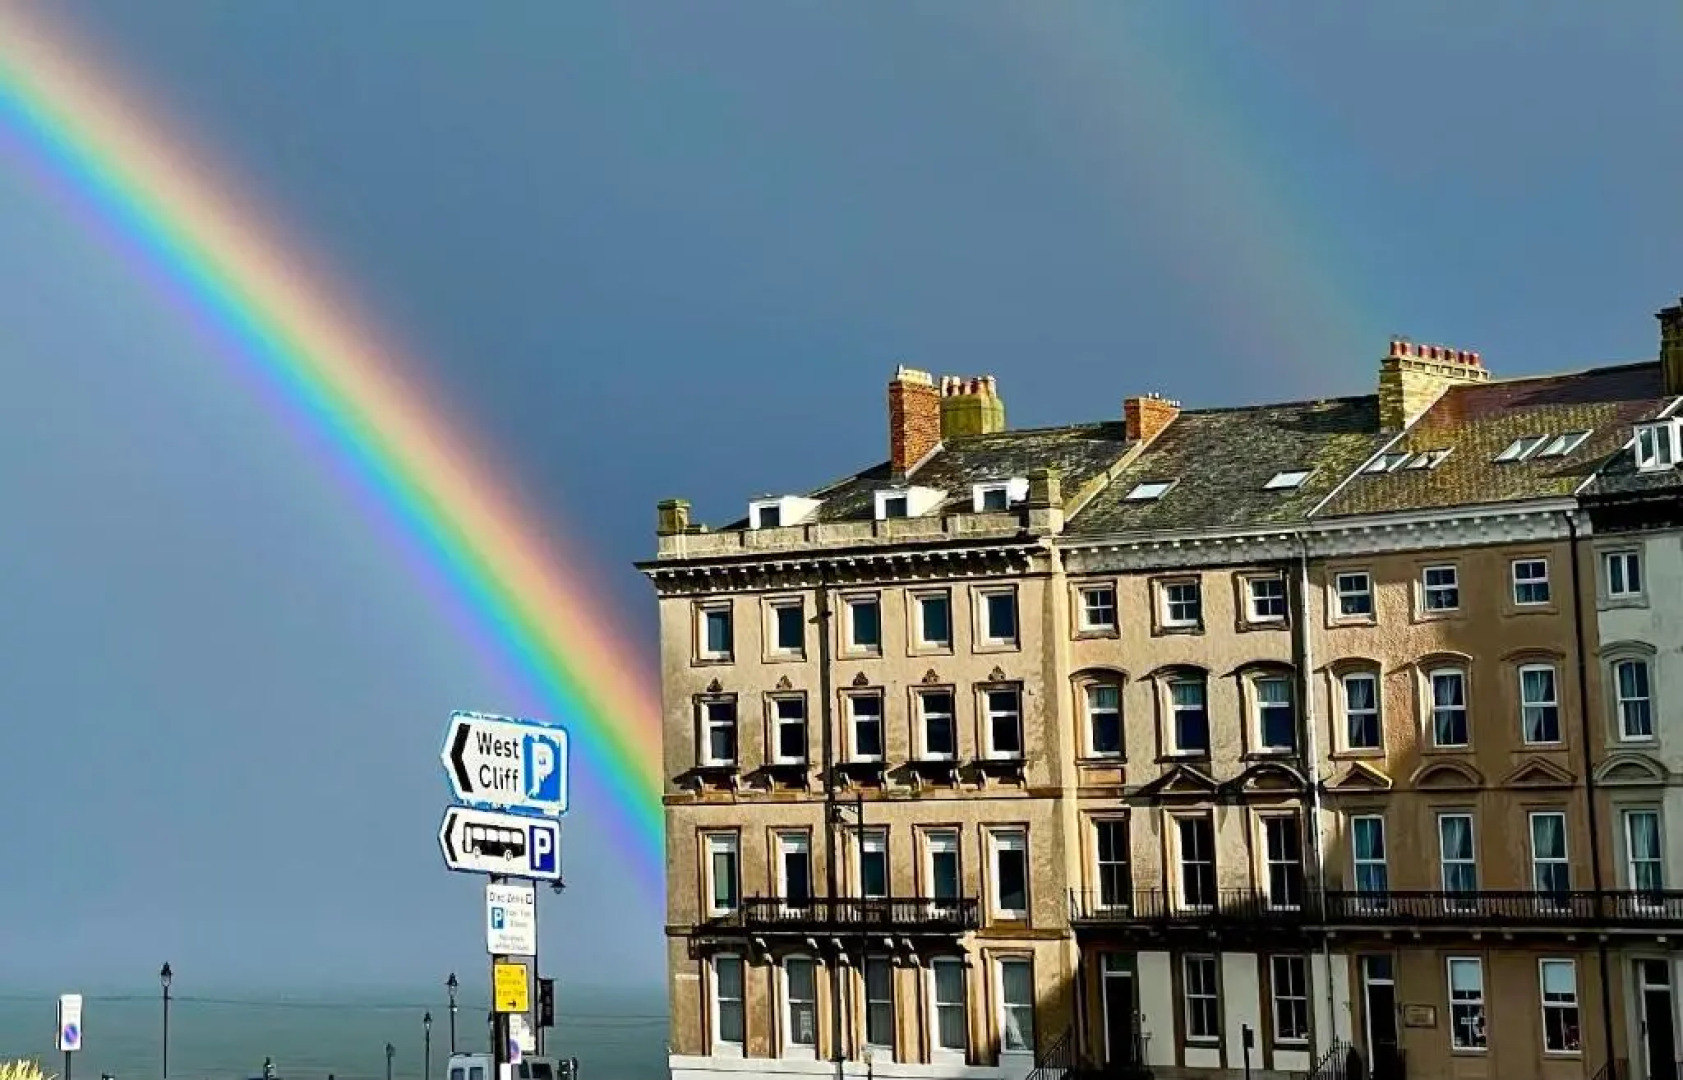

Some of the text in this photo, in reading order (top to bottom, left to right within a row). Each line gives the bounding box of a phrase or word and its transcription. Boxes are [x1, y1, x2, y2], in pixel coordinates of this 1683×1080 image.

[476, 730, 519, 759] West
[479, 763, 519, 792] Cliff
[532, 742, 555, 795] P
[533, 828, 551, 868] P
[494, 908, 503, 928] P
